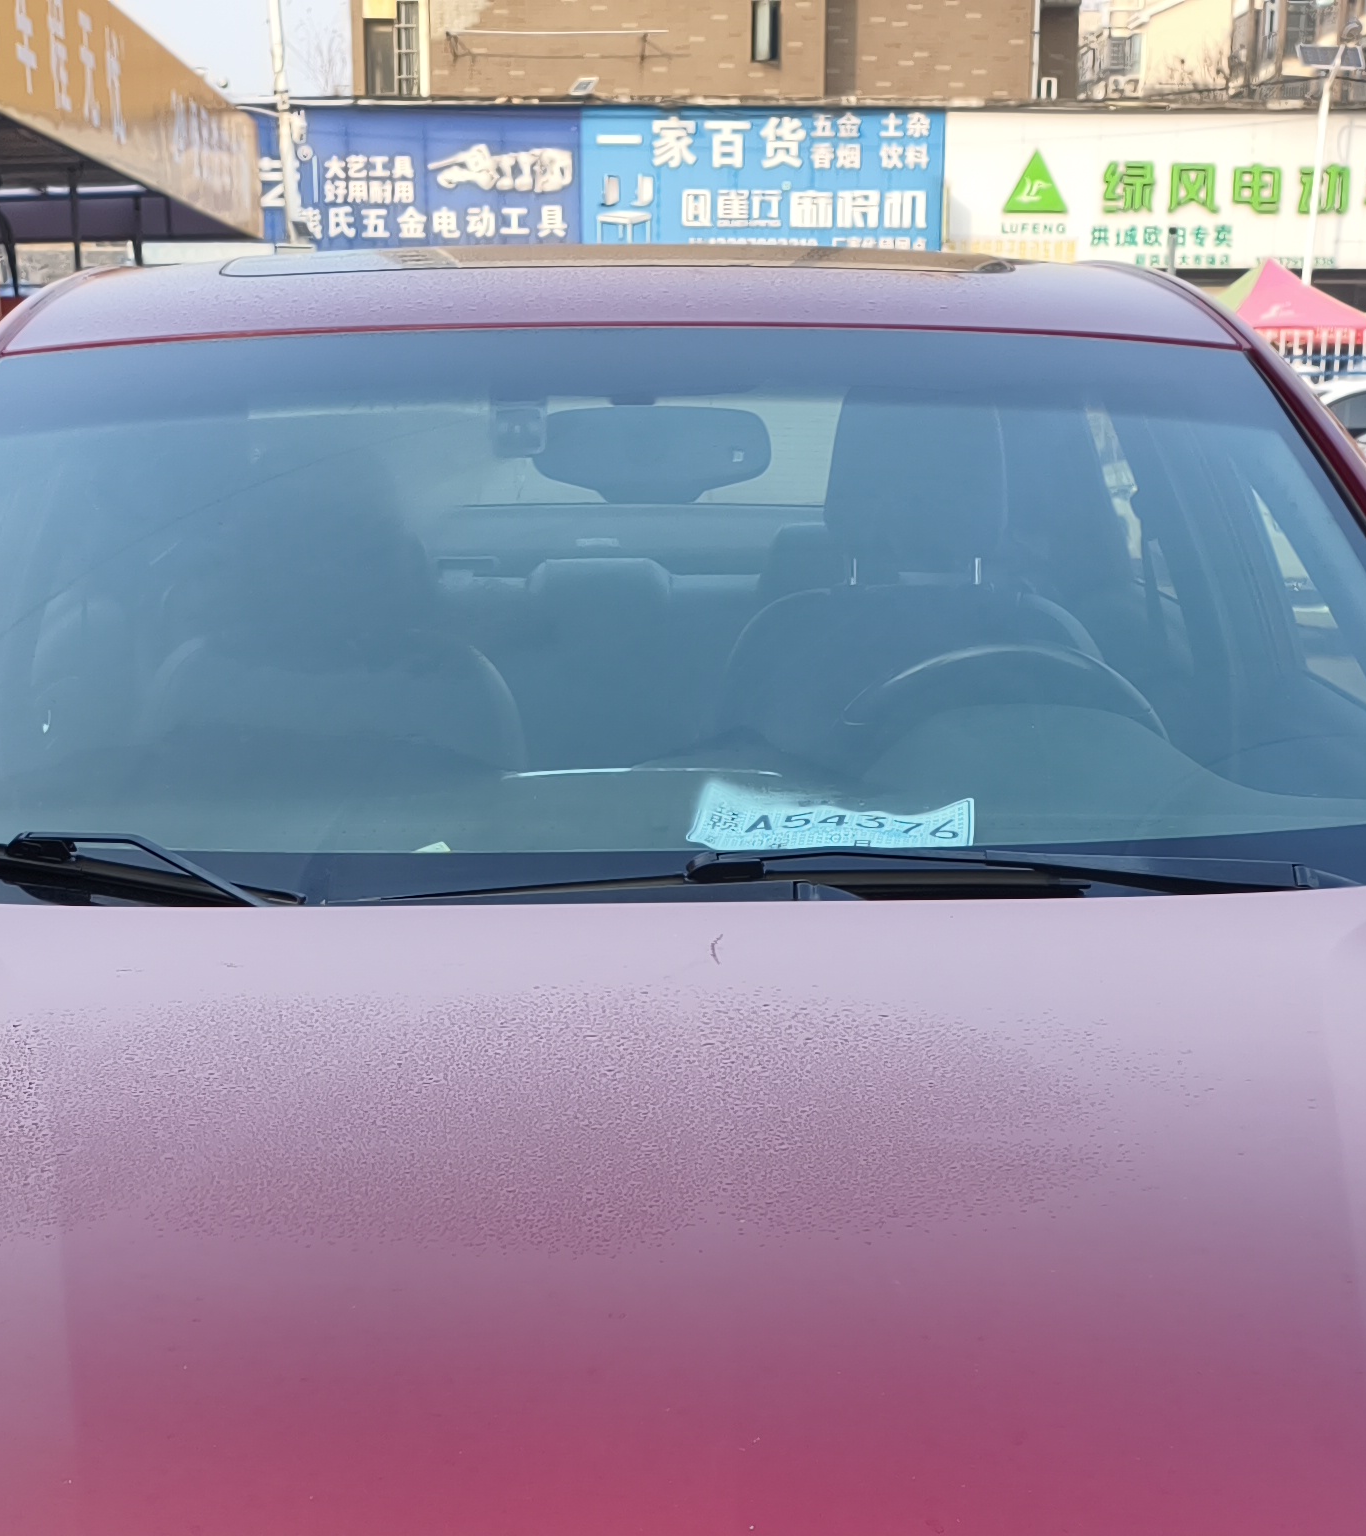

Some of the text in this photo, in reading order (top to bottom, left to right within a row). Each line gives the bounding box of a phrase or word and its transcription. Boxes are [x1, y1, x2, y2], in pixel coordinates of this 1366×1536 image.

[810, 112, 862, 138] 五金
[596, 116, 807, 169] 一家百货
[324, 156, 414, 178] 大艺工具
[810, 143, 929, 169] 香烟 饮料
[324, 181, 414, 203] 好用耐用
[1002, 223, 1066, 234] LUFENG
